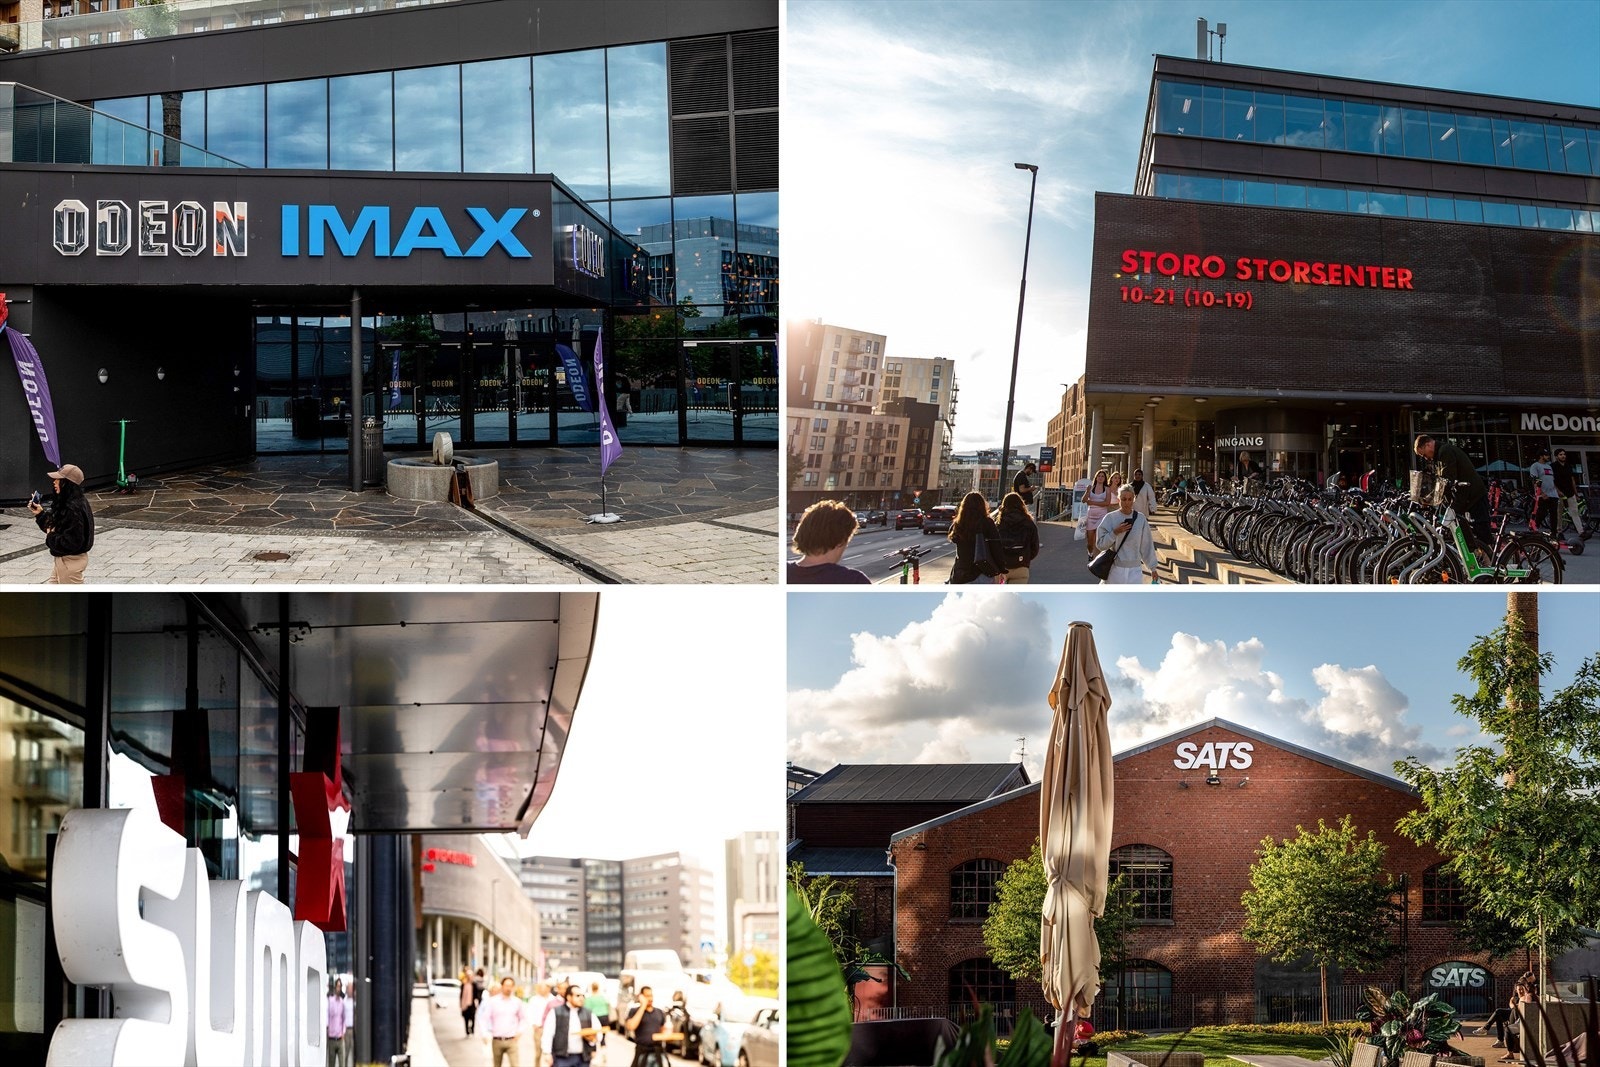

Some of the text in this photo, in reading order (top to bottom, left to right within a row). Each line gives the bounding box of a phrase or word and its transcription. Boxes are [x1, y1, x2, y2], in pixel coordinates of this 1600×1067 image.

[53, 199, 533, 258] ODEON IMAX
[1121, 249, 1414, 290] STORO STORSENTER
[1120, 285, 1254, 311] 10-21 (10-19)
[431, 380, 454, 388] ODEON
[479, 379, 502, 387] ODEON
[521, 378, 544, 386] ODEON
[696, 377, 721, 385] ODEON
[752, 377, 777, 385] ODEON
[1173, 741, 1254, 770] SATS
[1429, 967, 1486, 987] SATS
